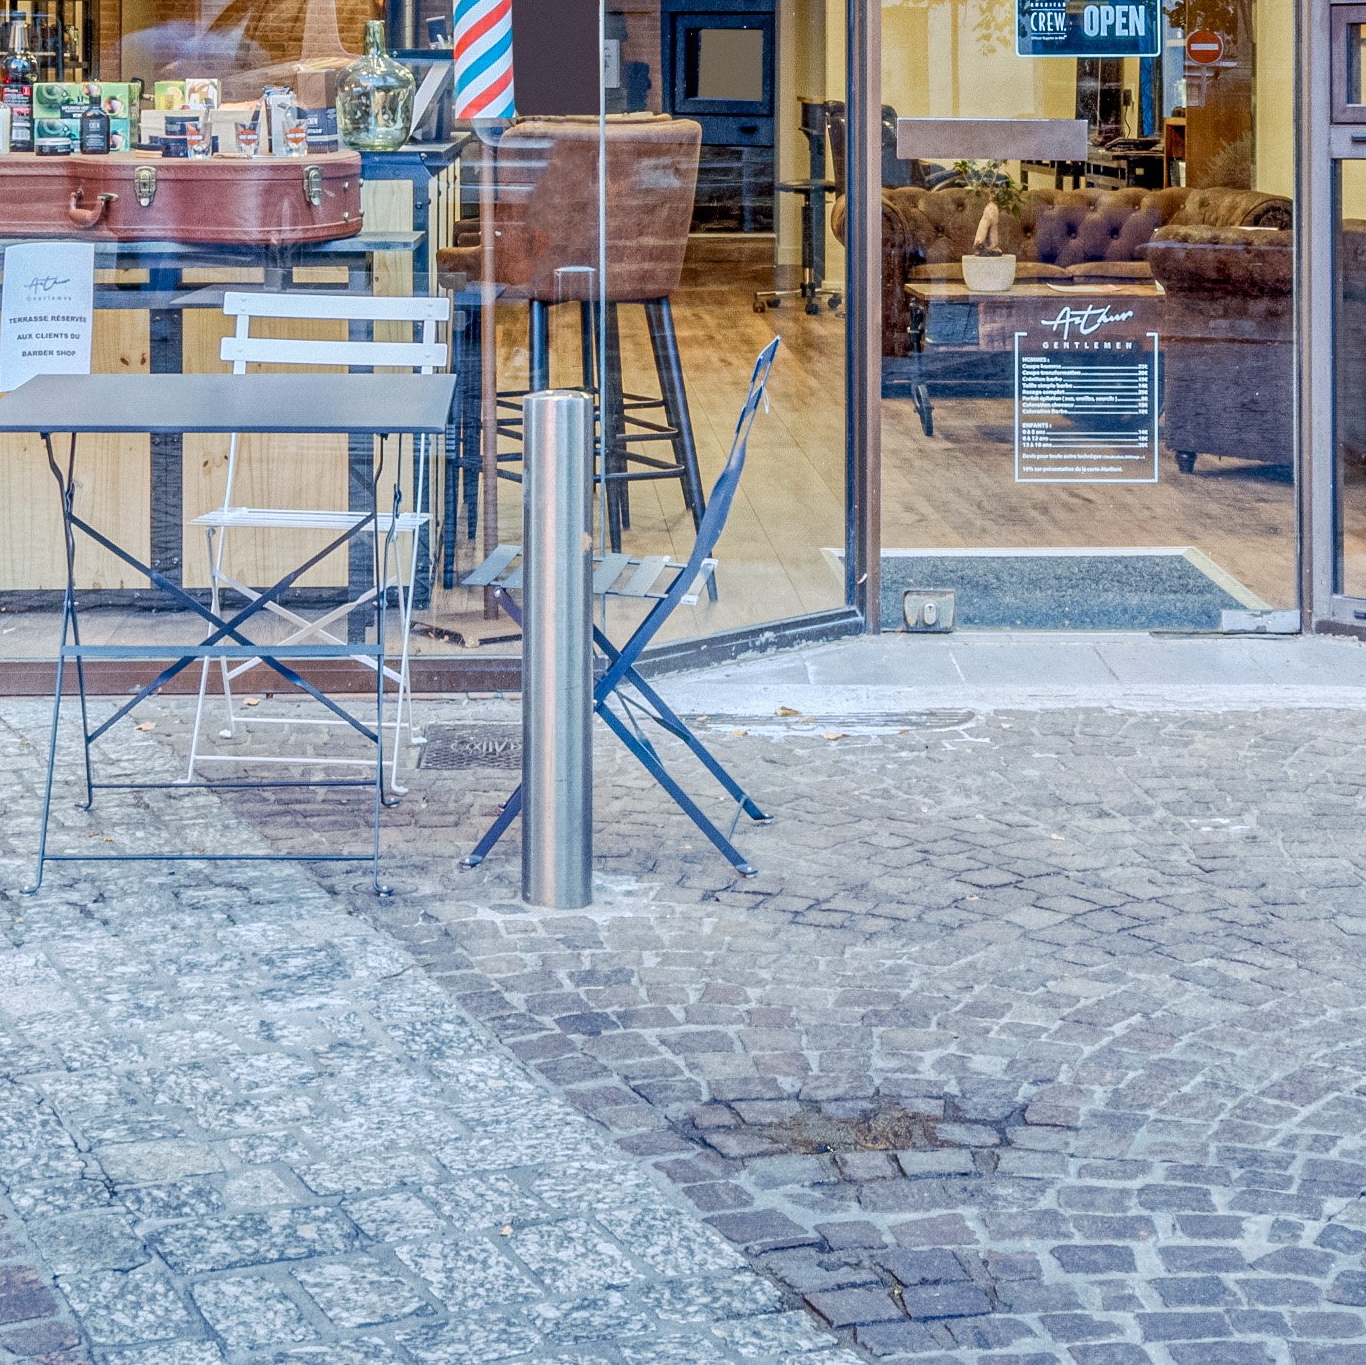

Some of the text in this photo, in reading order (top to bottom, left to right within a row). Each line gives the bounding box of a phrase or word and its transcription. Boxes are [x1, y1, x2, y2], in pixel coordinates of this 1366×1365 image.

[1084, 5, 1145, 36] OPEN
[9, 316, 48, 324] TERRASSE
[1041, 304, 1133, 340] Arthur
